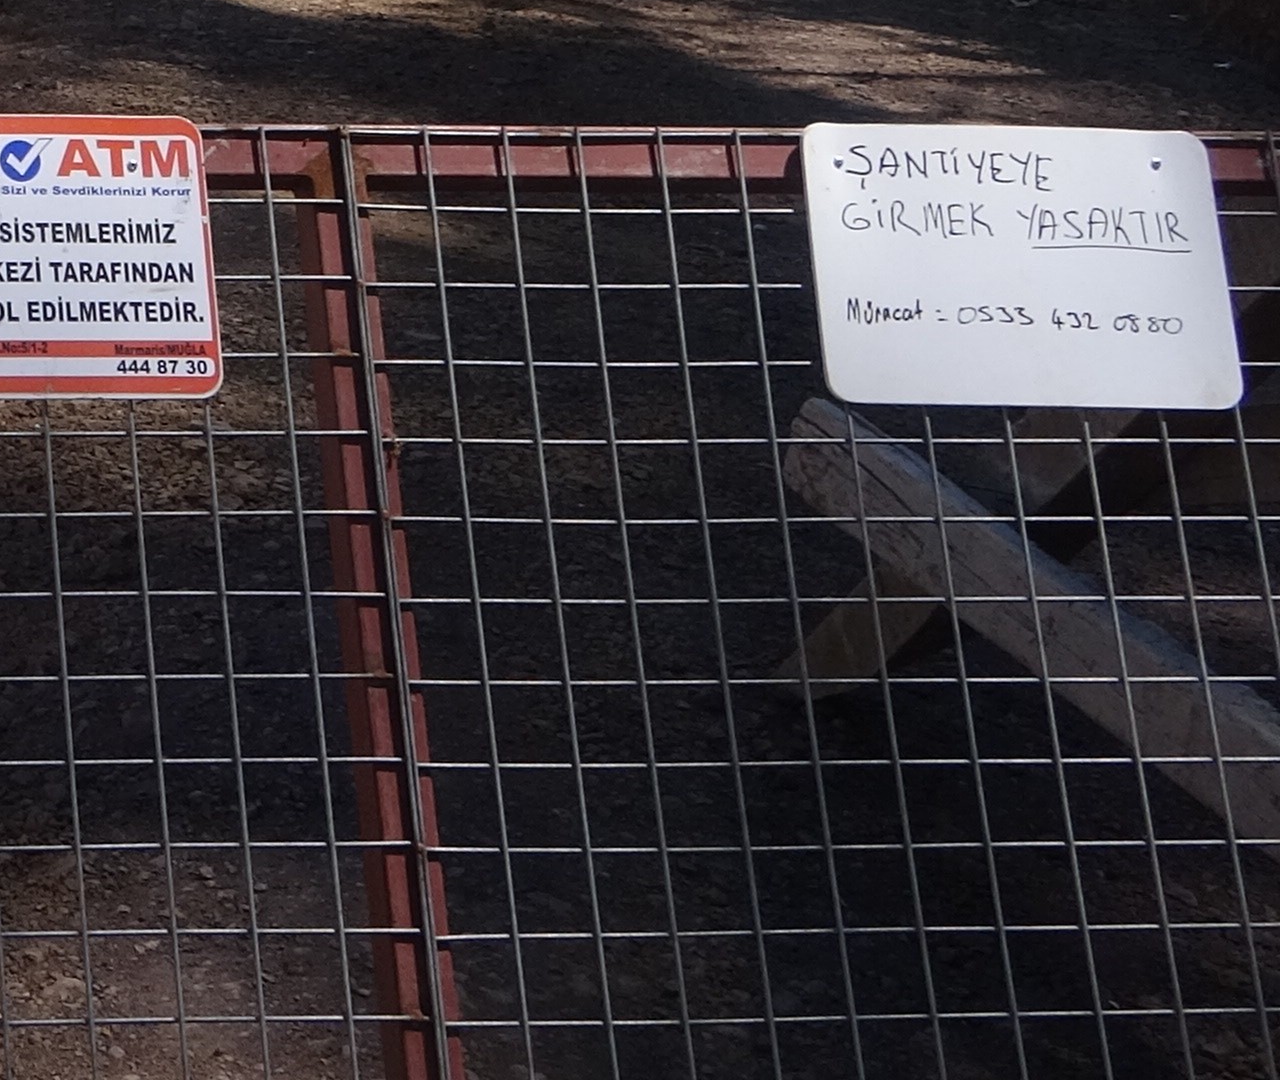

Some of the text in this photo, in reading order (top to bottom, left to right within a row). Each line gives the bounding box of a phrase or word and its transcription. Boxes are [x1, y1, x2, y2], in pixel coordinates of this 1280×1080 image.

[57, 139, 189, 177] ATM
[845, 145, 1056, 191] ŞANTİYEYE
[1, 186, 26, 195] Sizi
[52, 186, 146, 196] Sevdiklerinizi
[152, 187, 191, 196] Korur
[0, 218, 177, 244] SİSTEMLERİMİZ
[841, 199, 1189, 245] GİRMEK YASAKTIR
[49, 261, 194, 283] TARAFINDAN
[27, 296, 205, 322] EDİLMEKTEDİR.
[958, 307, 1035, 326] 0533
[1052, 308, 1100, 330] 432
[117, 360, 207, 374] 444 87 30
